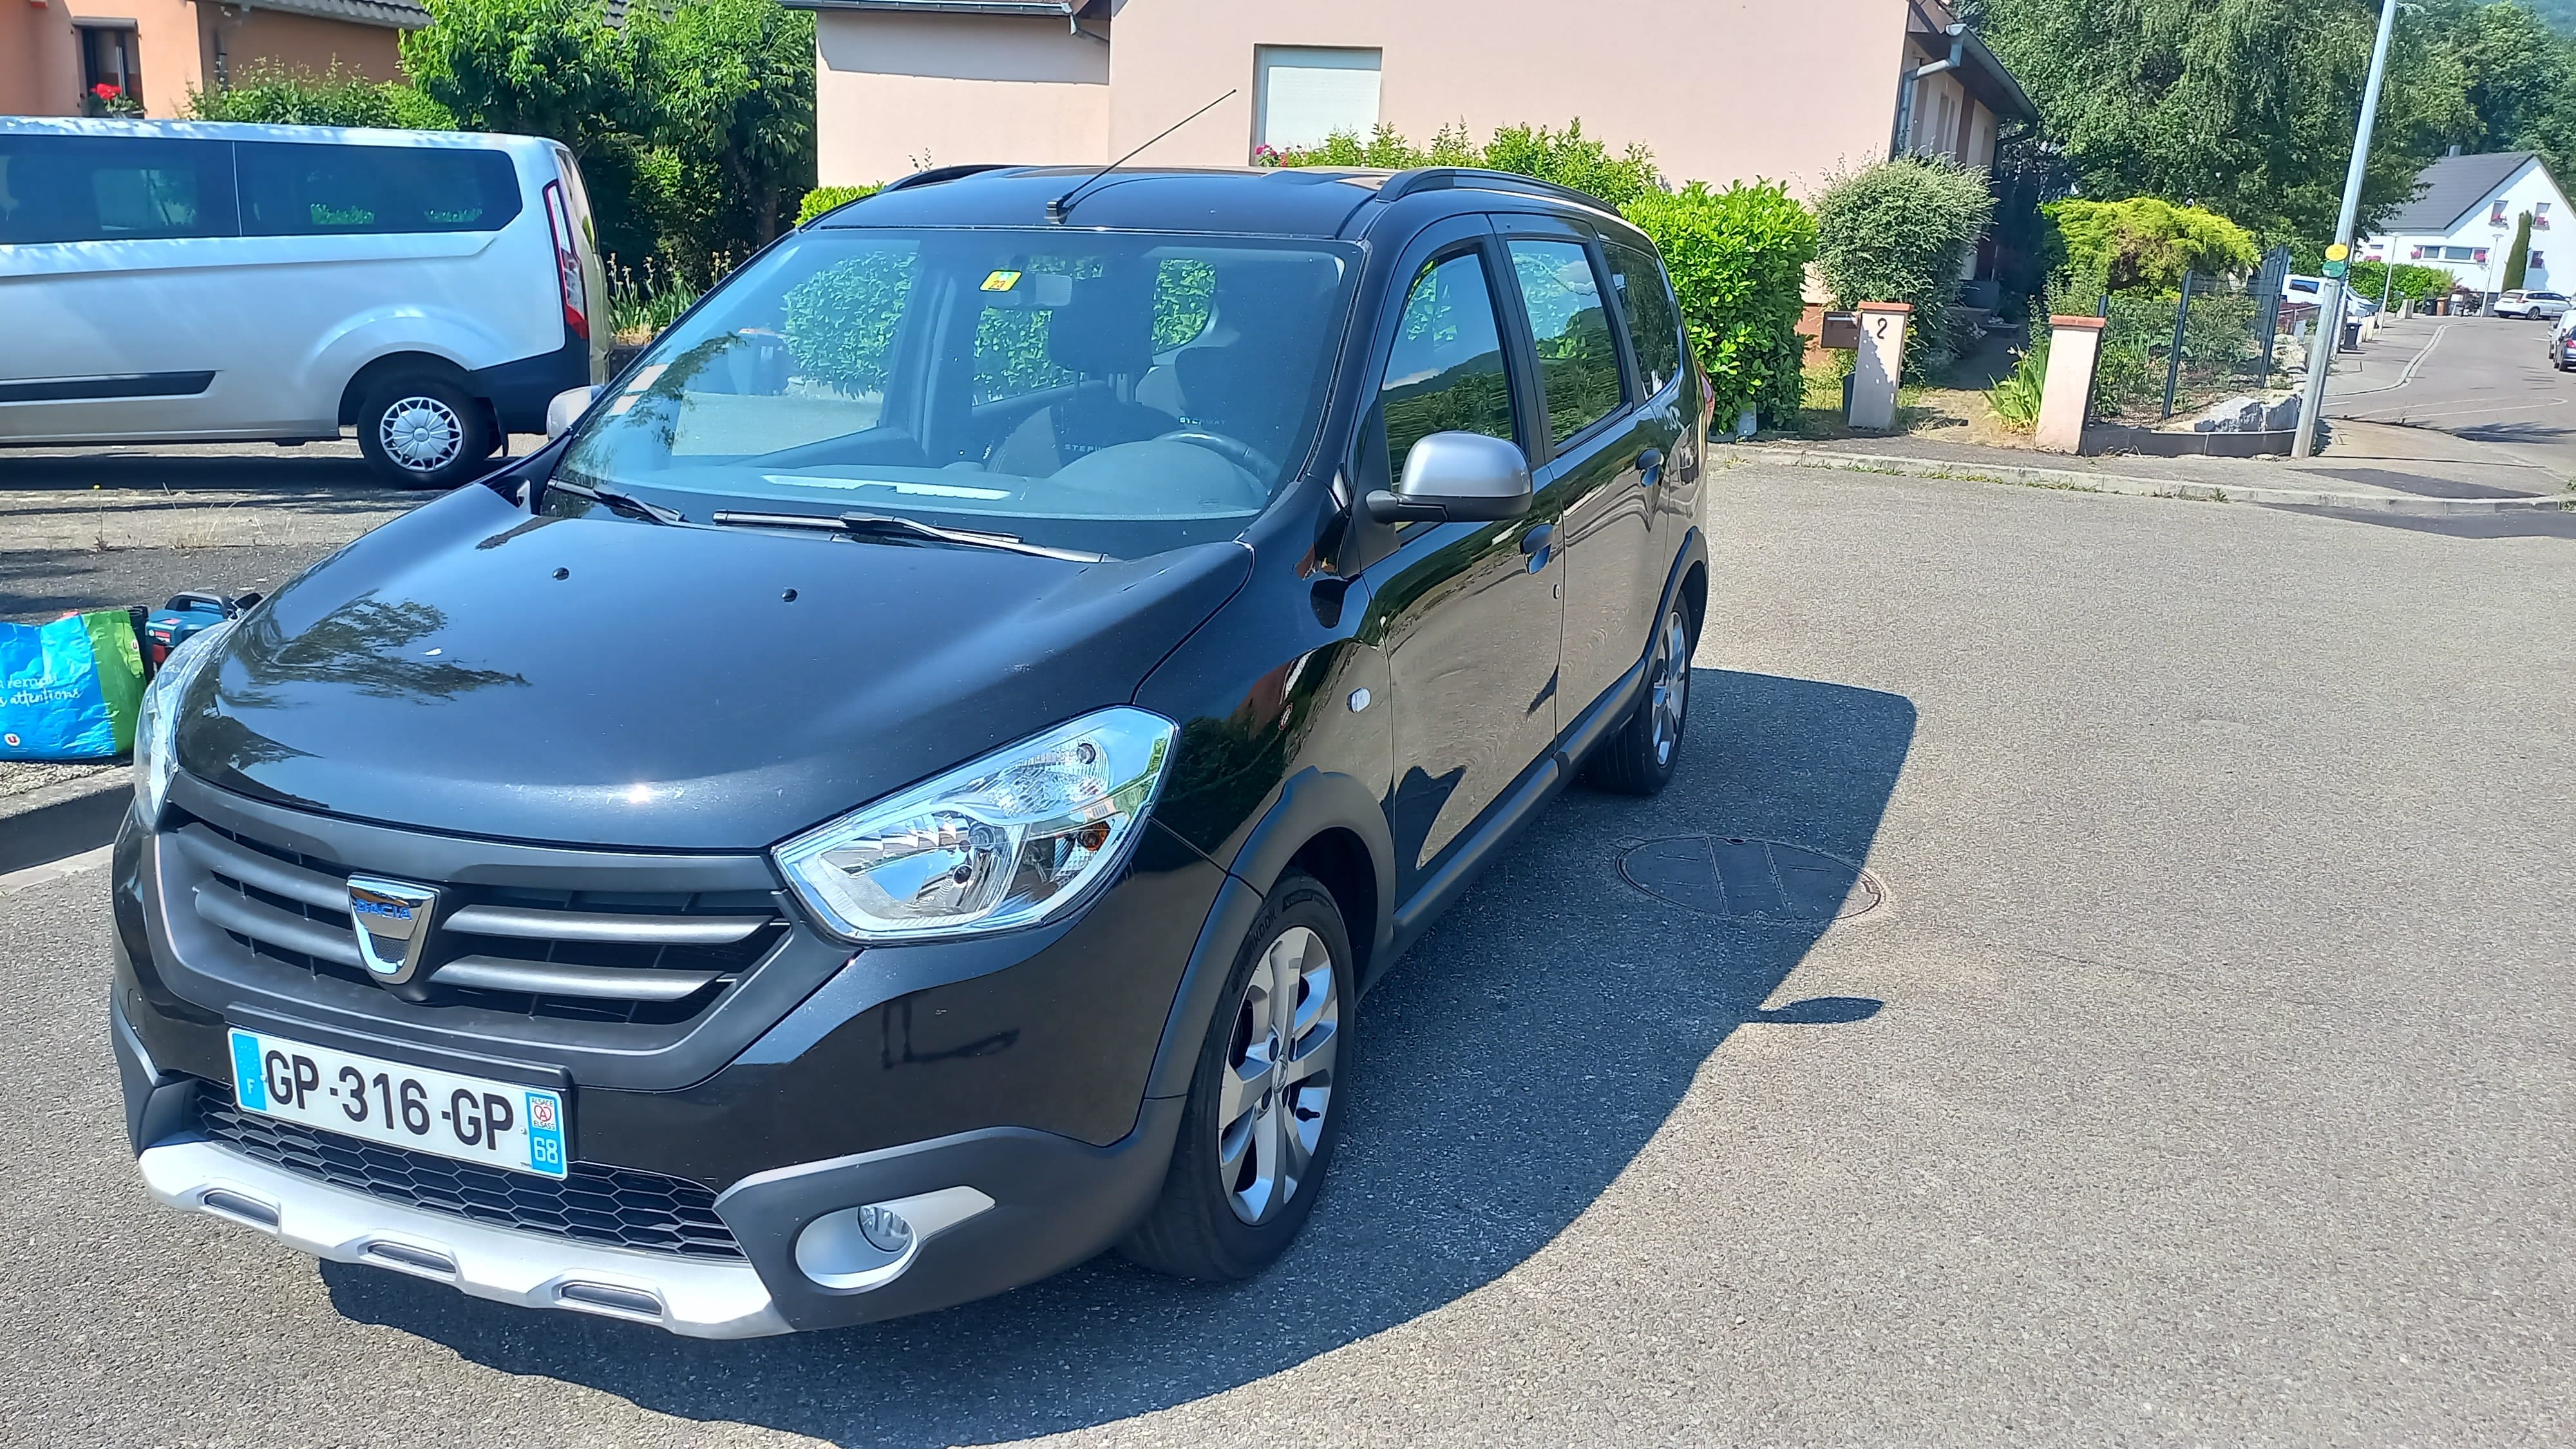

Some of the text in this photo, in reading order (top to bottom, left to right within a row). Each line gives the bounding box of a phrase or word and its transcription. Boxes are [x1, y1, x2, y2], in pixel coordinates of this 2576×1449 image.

[1877, 317, 1888, 339] 2
[357, 898, 413, 922] DACIA
[247, 1077, 255, 1095] F
[265, 1050, 514, 1151] GP-316-GP
[531, 1097, 554, 1107] ALSACE
[533, 1120, 556, 1130] ELSASS
[533, 1136, 559, 1165] 68
